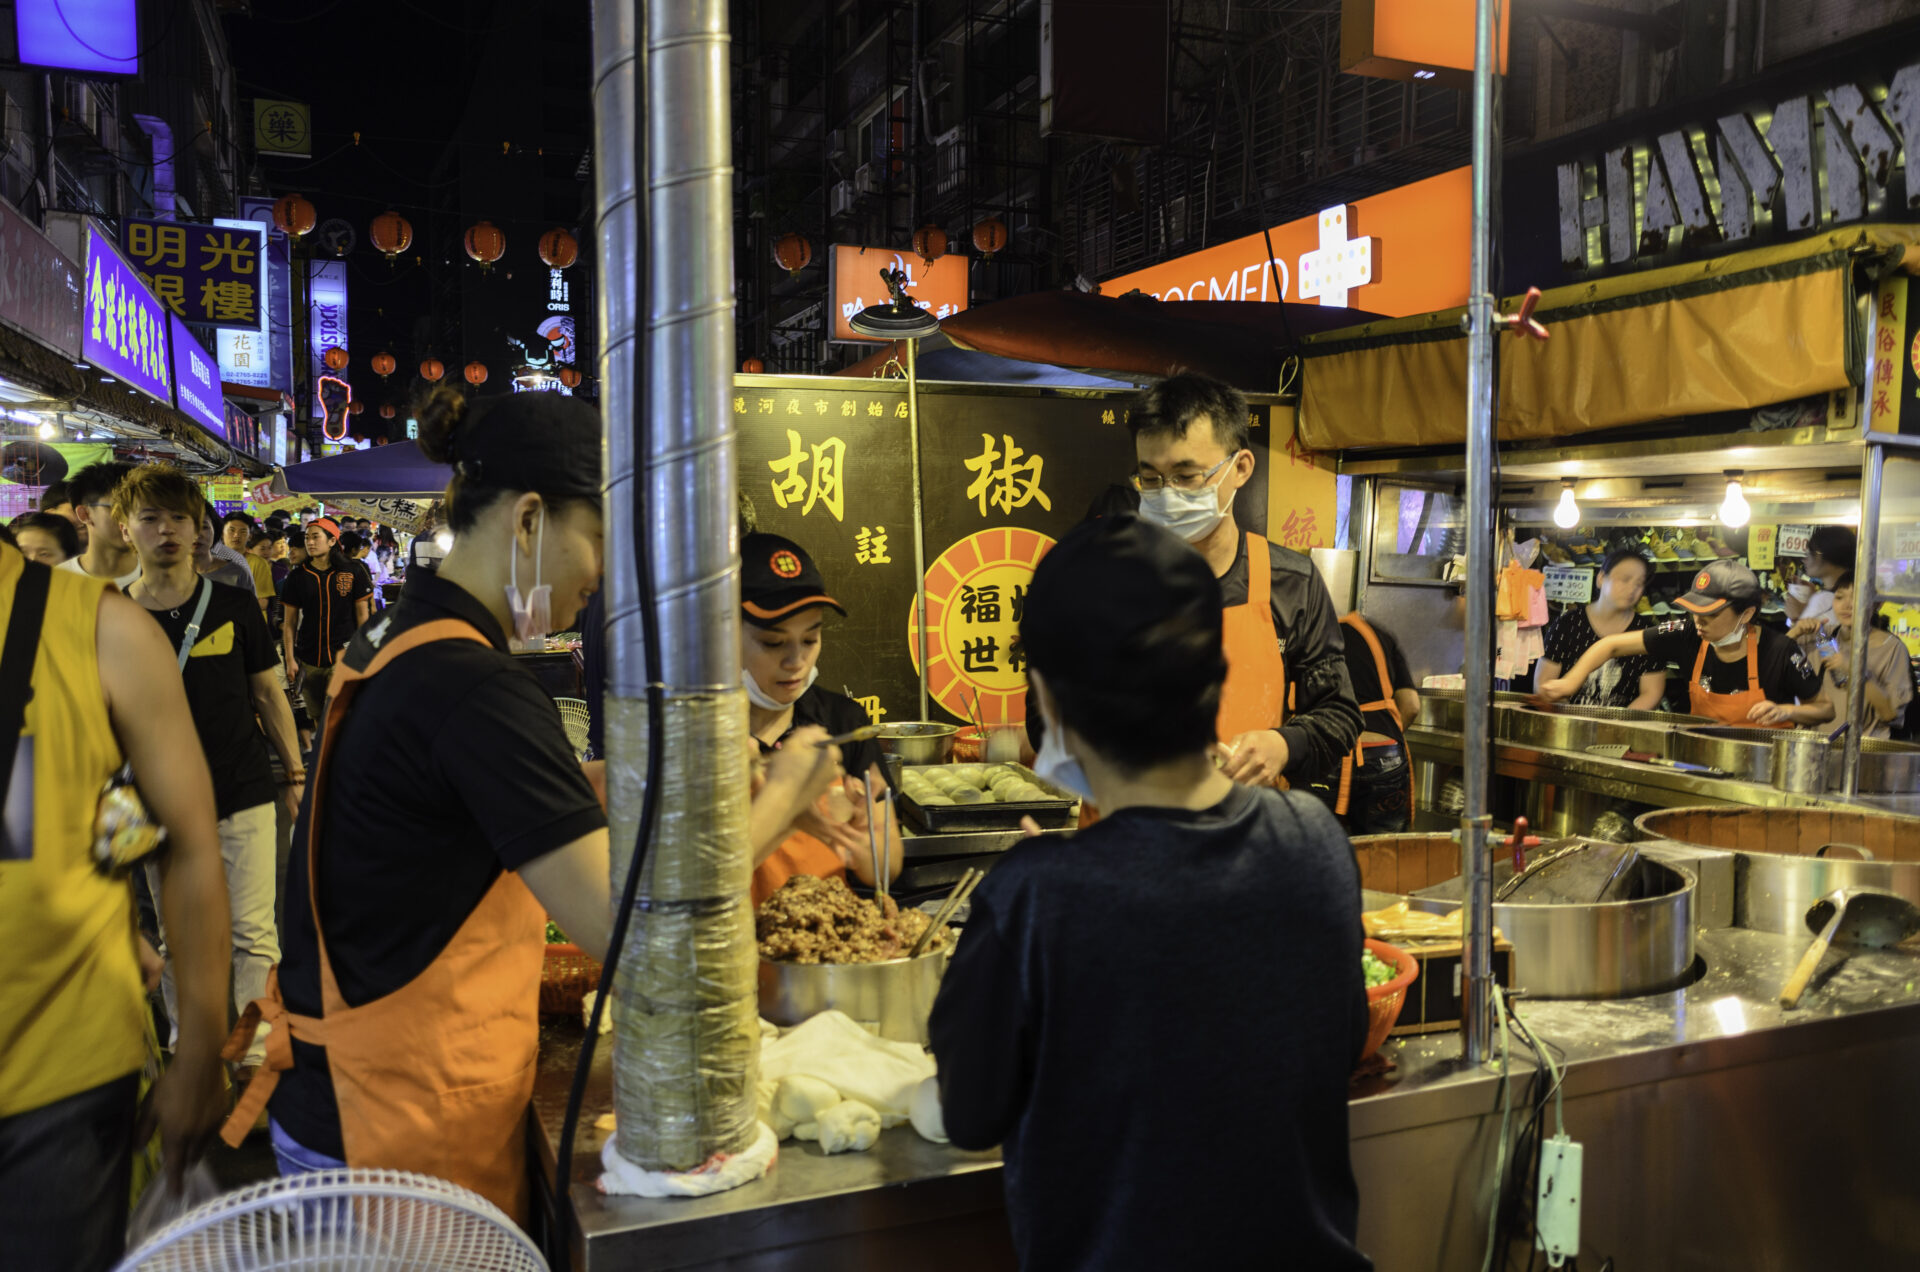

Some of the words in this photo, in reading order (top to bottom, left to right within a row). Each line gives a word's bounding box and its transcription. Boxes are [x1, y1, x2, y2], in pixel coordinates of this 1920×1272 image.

[268, 111, 297, 143] 藥
[129, 223, 255, 274] 明光
[547, 303, 570, 311] ORIS
[233, 333, 251, 369] 花園
[1873, 293, 1897, 417] 民俗傳承
